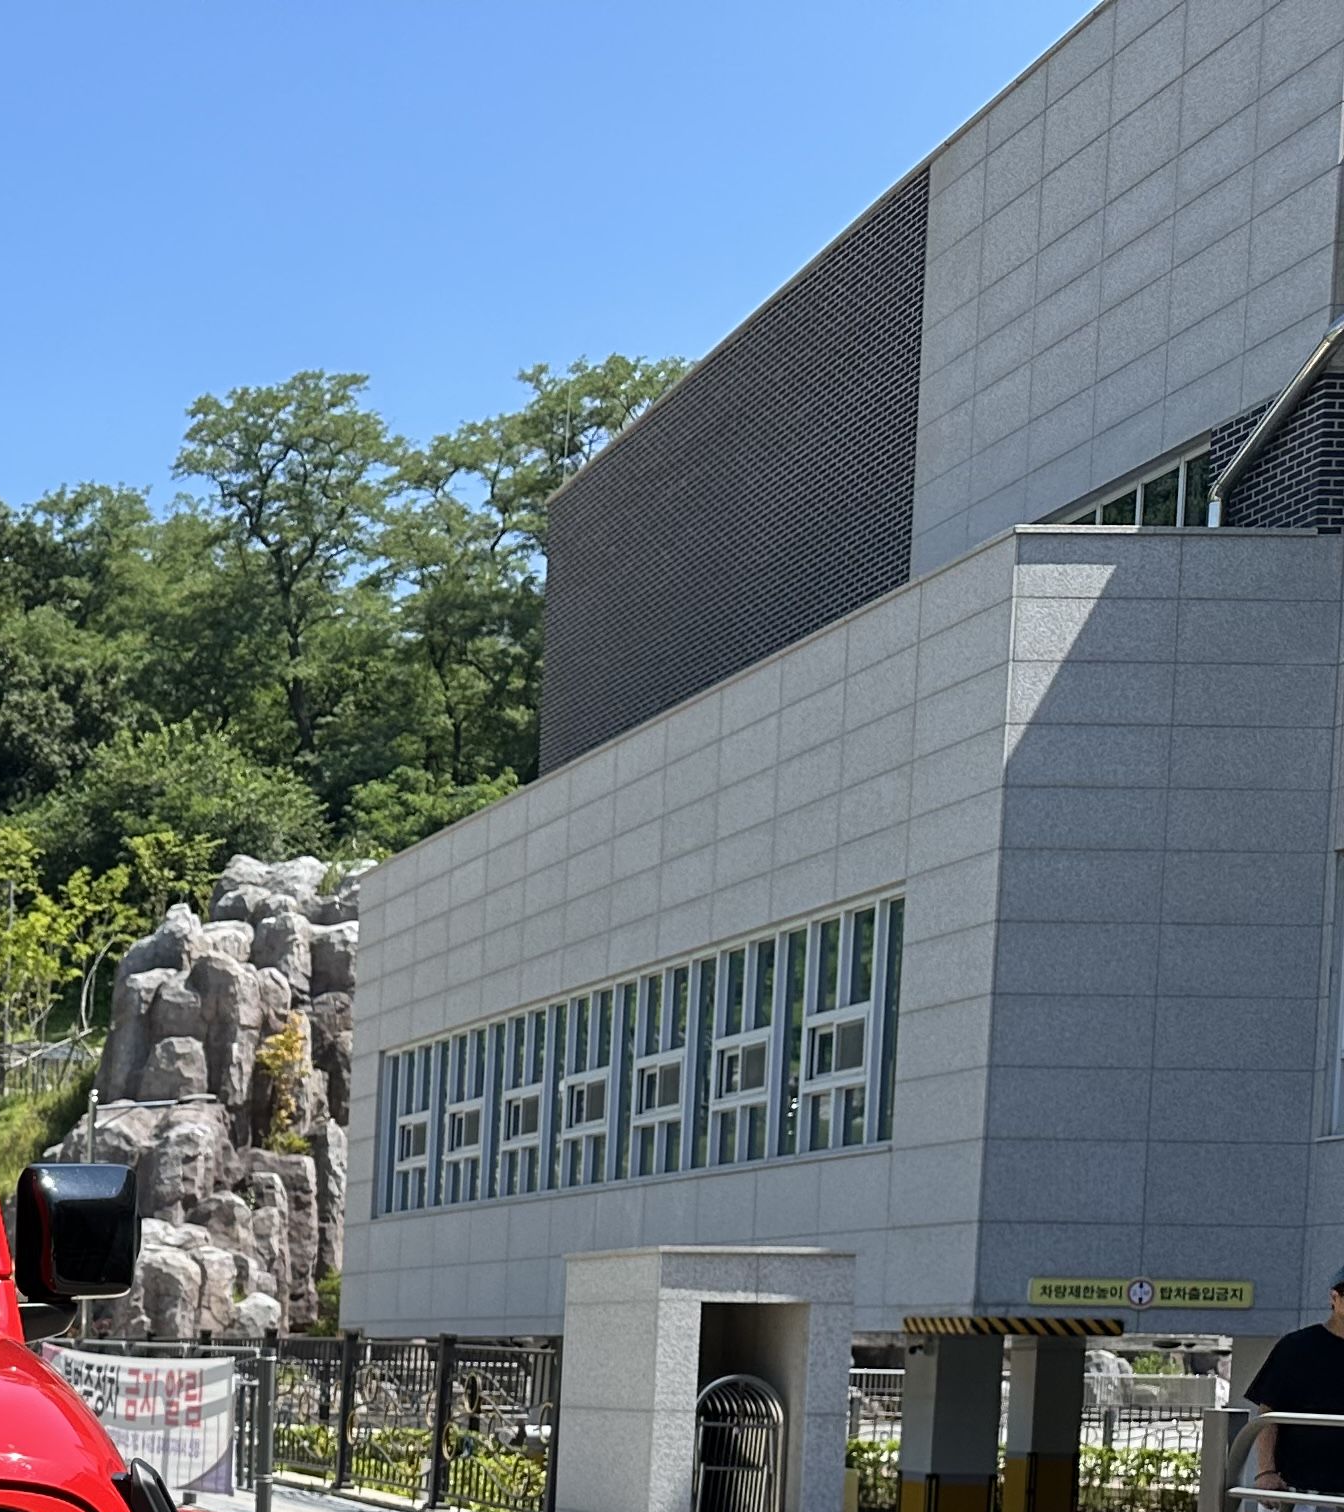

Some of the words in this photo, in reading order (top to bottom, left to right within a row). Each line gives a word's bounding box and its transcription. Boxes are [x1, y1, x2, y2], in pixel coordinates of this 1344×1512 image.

[1040, 1284, 1123, 1300] 차량제한높이
[124, 1367, 159, 1425] 금지
[164, 1367, 204, 1428] 알림
